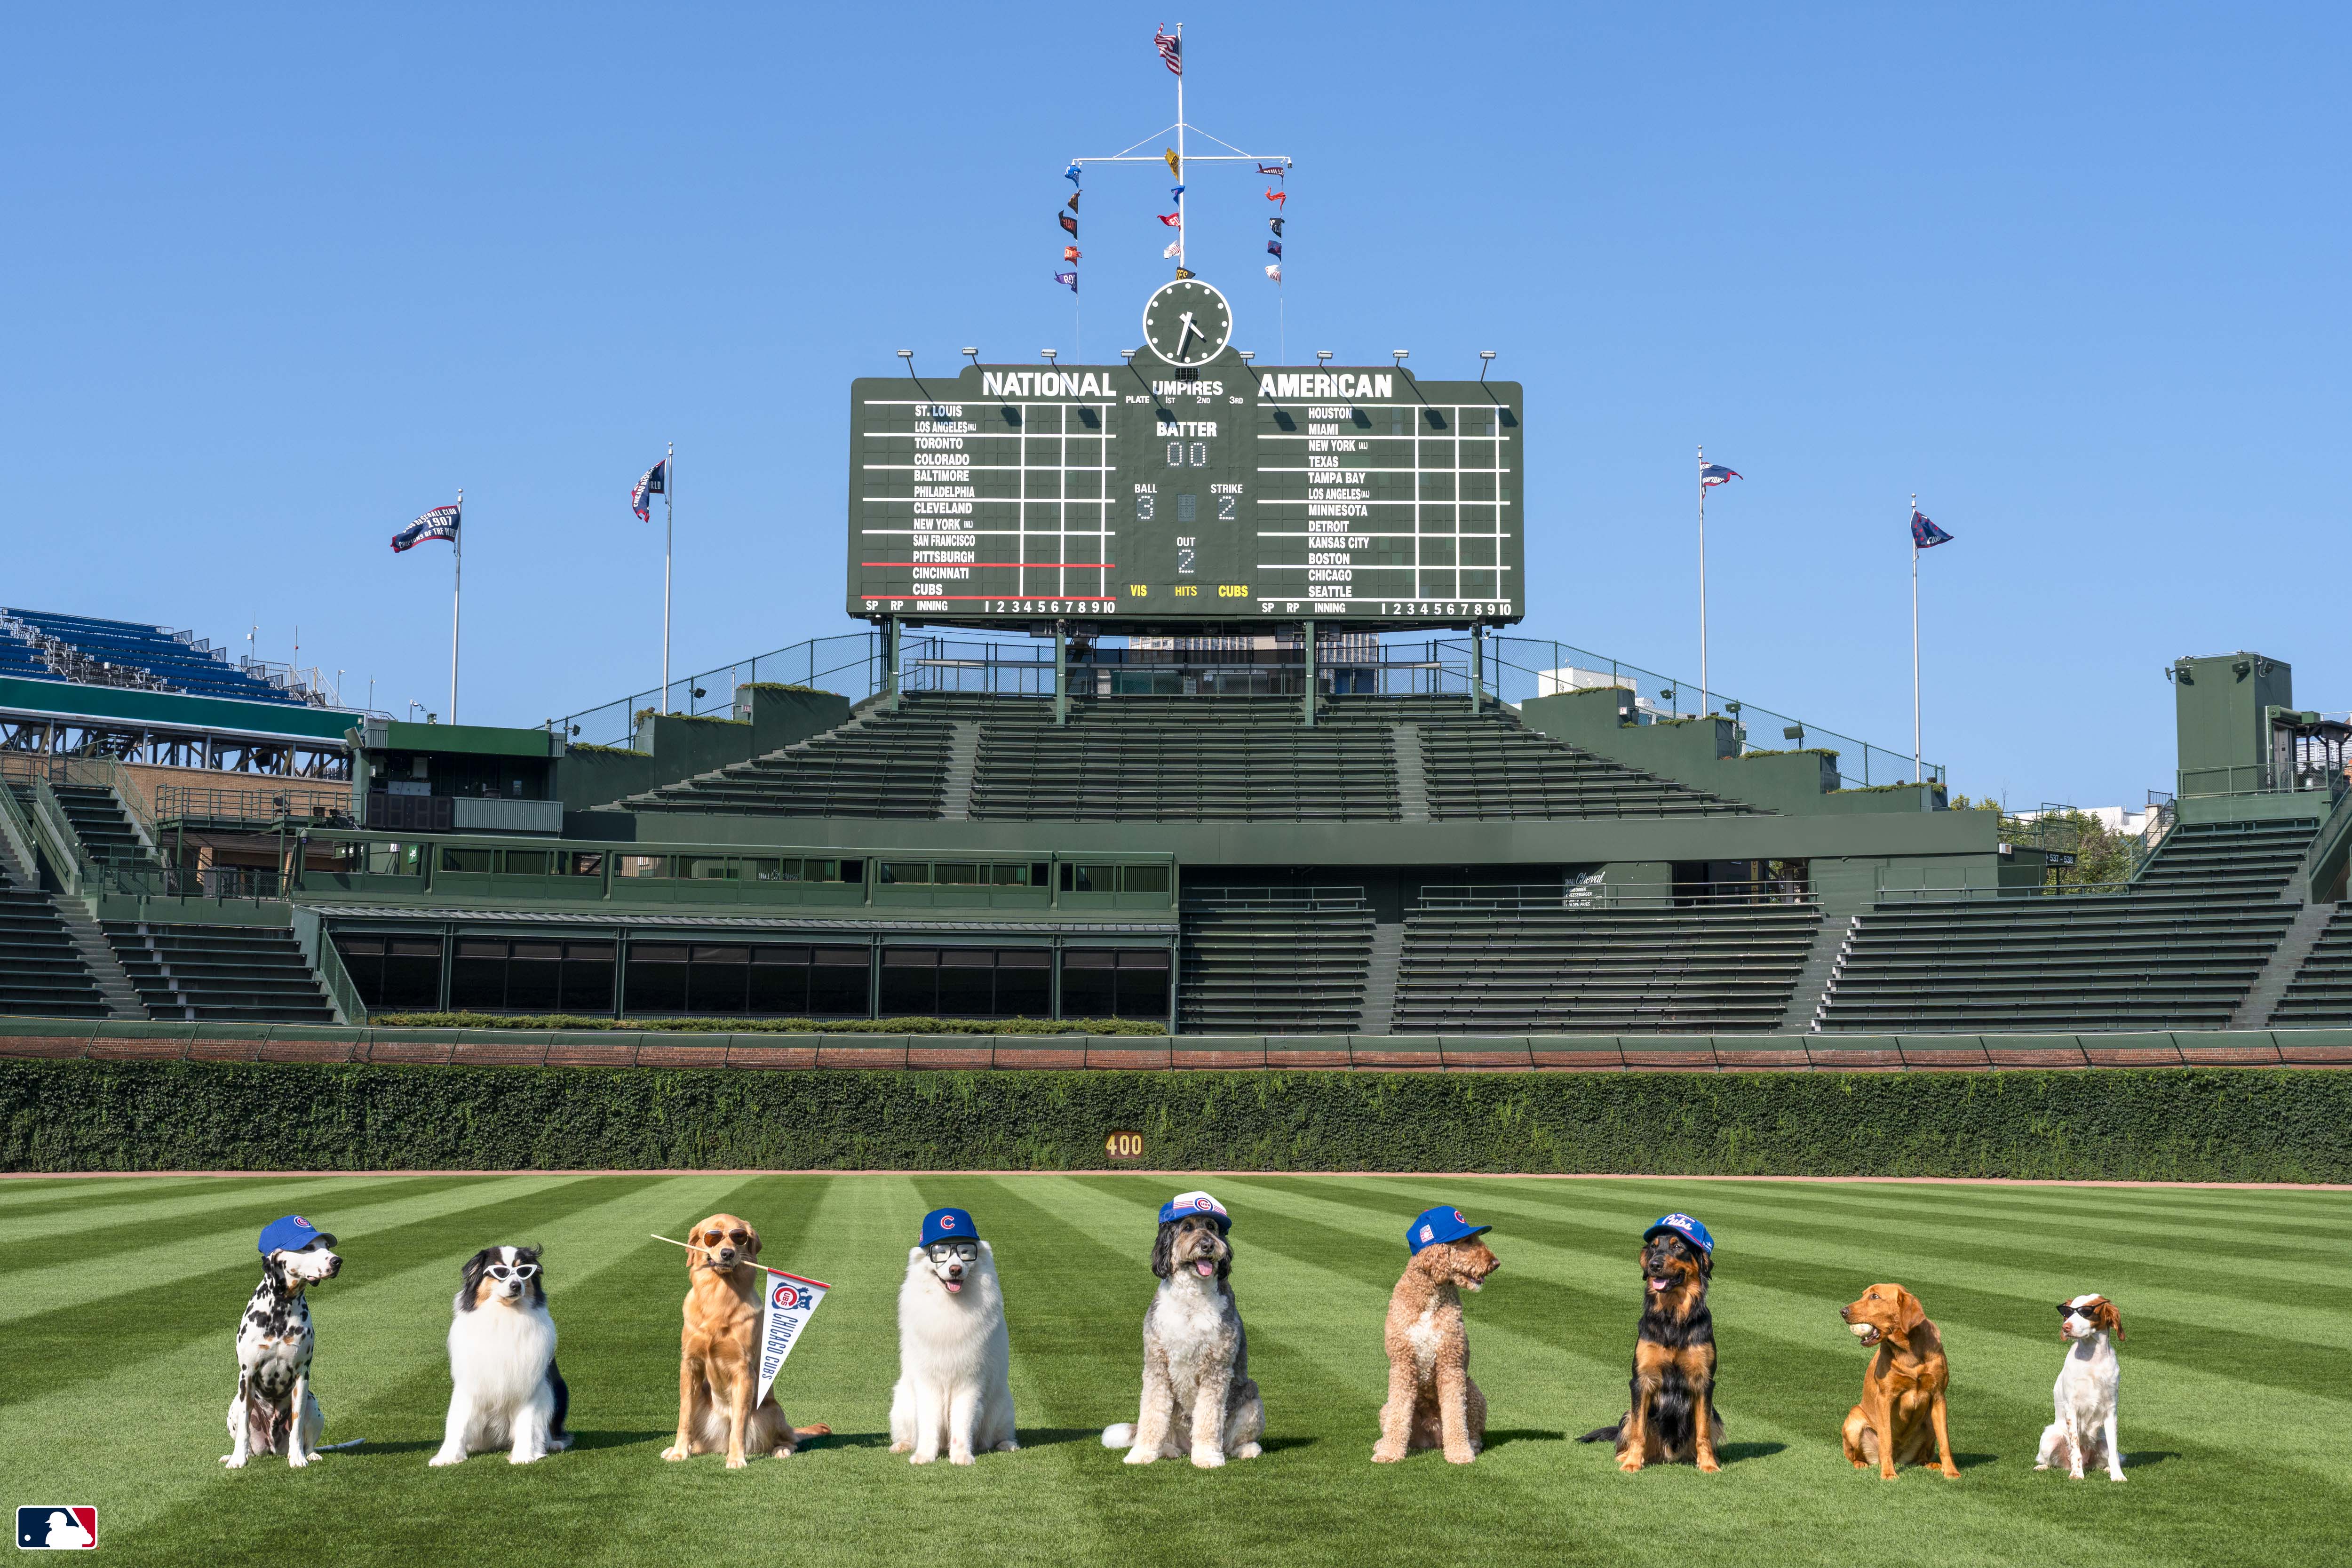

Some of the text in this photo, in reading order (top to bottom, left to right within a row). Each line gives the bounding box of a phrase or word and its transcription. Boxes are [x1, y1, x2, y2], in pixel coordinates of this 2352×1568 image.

[983, 372, 1116, 396] NATIONAL
[1152, 380, 1223, 396] UMPIRES
[1258, 374, 1391, 398] AMERICAN
[915, 405, 962, 417] ST. LOUIS
[1309, 407, 1352, 419] HOUSTON
[915, 421, 930, 433] LOS
[1157, 422, 1217, 437] BATTER
[1309, 424, 1338, 435] MIAMI
[914, 437, 964, 449] TORONTO
[1309, 440, 1328, 451] NEW
[1331, 440, 1355, 451] YORK
[914, 454, 969, 465] COLORADO
[1309, 456, 1338, 467] TEXAS
[914, 469, 970, 481] BALTIMORE
[1308, 472, 1366, 484] TAMPA BAY
[914, 486, 975, 497] PHILADELPHIA
[1135, 484, 1157, 493] BALL
[1211, 484, 1243, 493] STRIKE
[1309, 488, 1324, 500] LOS
[914, 501, 972, 514] CLEVELAND
[1138, 496, 1153, 519] 3
[1219, 496, 1234, 520] 2
[1309, 504, 1367, 516] MINNESOTA
[426, 516, 452, 528] 1907
[914, 518, 934, 530] NEW
[936, 518, 961, 530] YORK
[1309, 520, 1349, 532] DETROIT
[913, 534, 975, 546] SAN FRANCISCO
[1177, 537, 1195, 546] OUT
[1309, 537, 1369, 549] KANSAS CITY
[913, 551, 974, 562] PITTSBURGH
[1179, 549, 1194, 573] 2
[1309, 553, 1350, 564] BOSTON
[913, 567, 969, 579] CINCINNATI
[1309, 569, 1352, 581] CHICAGO
[913, 583, 942, 595] CUBS
[1130, 585, 1147, 597] VIS
[1176, 586, 1197, 596] HITS
[1218, 585, 1248, 597] CUBS
[1309, 586, 1352, 597] SEATTLE
[866, 600, 878, 610] SP
[891, 601, 903, 610] RP
[917, 601, 947, 611] INNING
[985, 601, 989, 612] 1
[997, 601, 1004, 612] 2
[1012, 601, 1019, 612] 3
[1024, 601, 1032, 613] 4
[1038, 601, 1045, 613] 5
[1051, 601, 1058, 613] 6
[1065, 602, 1073, 613] 7
[1078, 602, 1086, 613] 8
[1092, 602, 1099, 613] 9
[1104, 602, 1115, 613] 10
[1262, 603, 1274, 613] SP
[1287, 603, 1299, 613] RP
[1315, 603, 1345, 613] INNING
[1382, 603, 1385, 614] 1
[1393, 603, 1401, 614] 2
[1407, 603, 1414, 614] 3
[1420, 604, 1428, 614] 4
[1434, 604, 1441, 614] 5
[1447, 604, 1454, 614] 6
[1461, 604, 1468, 615] 7
[1474, 604, 1482, 615] 8
[1487, 604, 1495, 615] 9
[1500, 604, 1511, 615] 10
[1576, 871, 1605, 884] Cheval
[1105, 1135, 1142, 1155] 400
[941, 1215, 955, 1229] C
[1662, 1214, 1692, 1230] Cubs
[762, 1313, 798, 1380] CHICAGO CUBS
